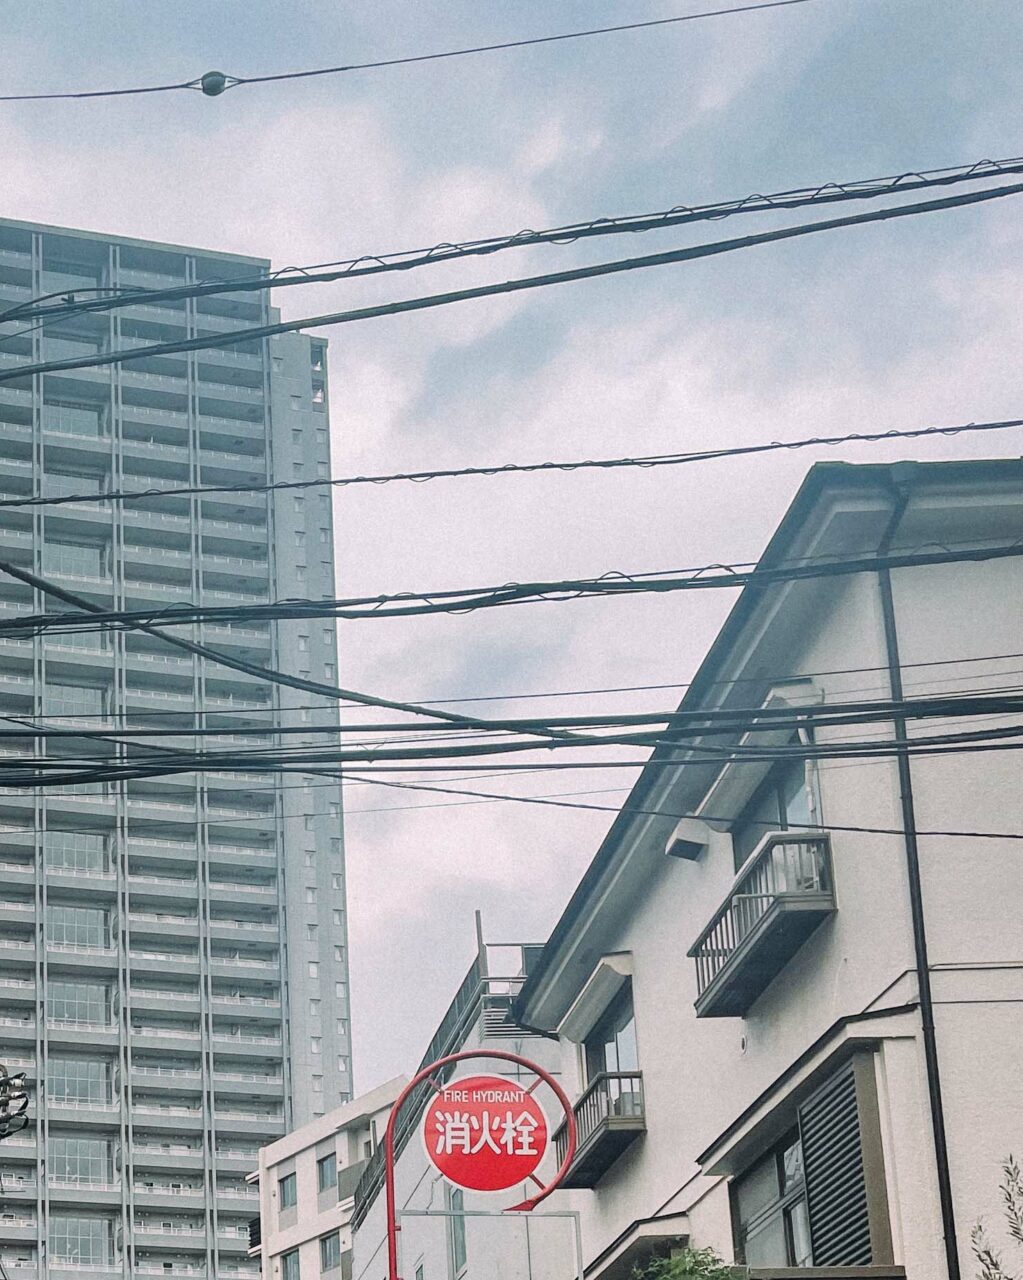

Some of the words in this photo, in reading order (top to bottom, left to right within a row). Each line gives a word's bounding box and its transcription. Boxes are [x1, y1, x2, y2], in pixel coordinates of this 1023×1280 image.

[443, 1090, 469, 1103] FIRE
[472, 1090, 526, 1103] HYDRANT
[434, 1110, 539, 1155] 消火栓
